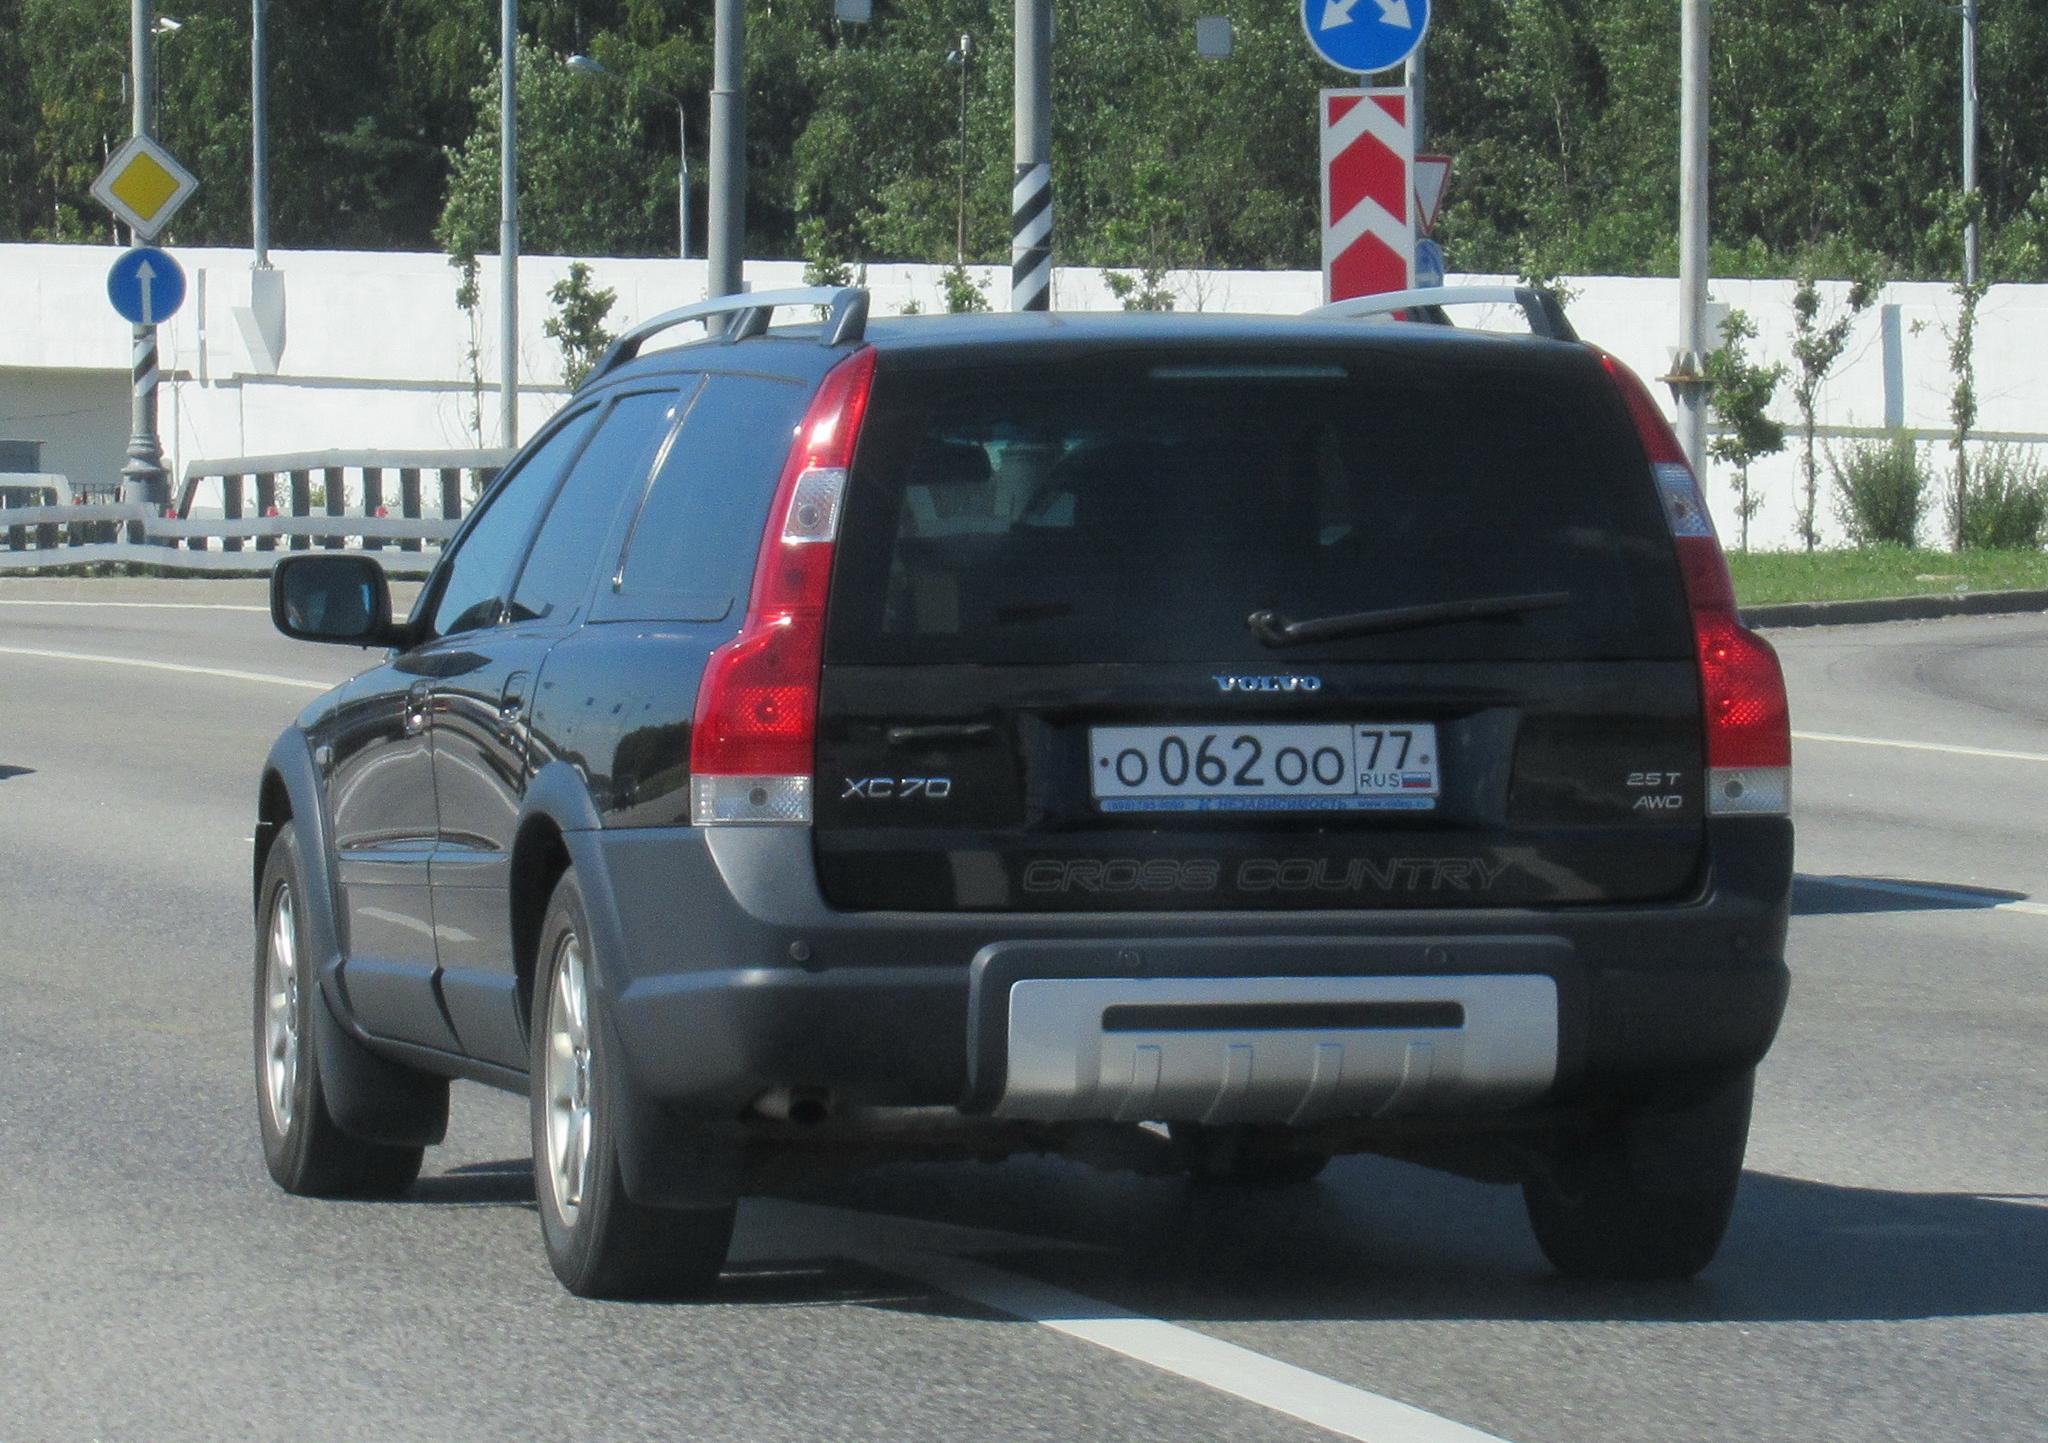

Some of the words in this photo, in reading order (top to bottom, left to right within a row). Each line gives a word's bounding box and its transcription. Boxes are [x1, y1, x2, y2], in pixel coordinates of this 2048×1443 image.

[1211, 674, 1322, 691] VOLVO
[1361, 730, 1413, 770] 77
[1360, 773, 1400, 788] RUS
[1633, 795, 1683, 810] AWD
[1022, 858, 1221, 893] CROSS
[1235, 857, 1514, 892] COUNTRY
